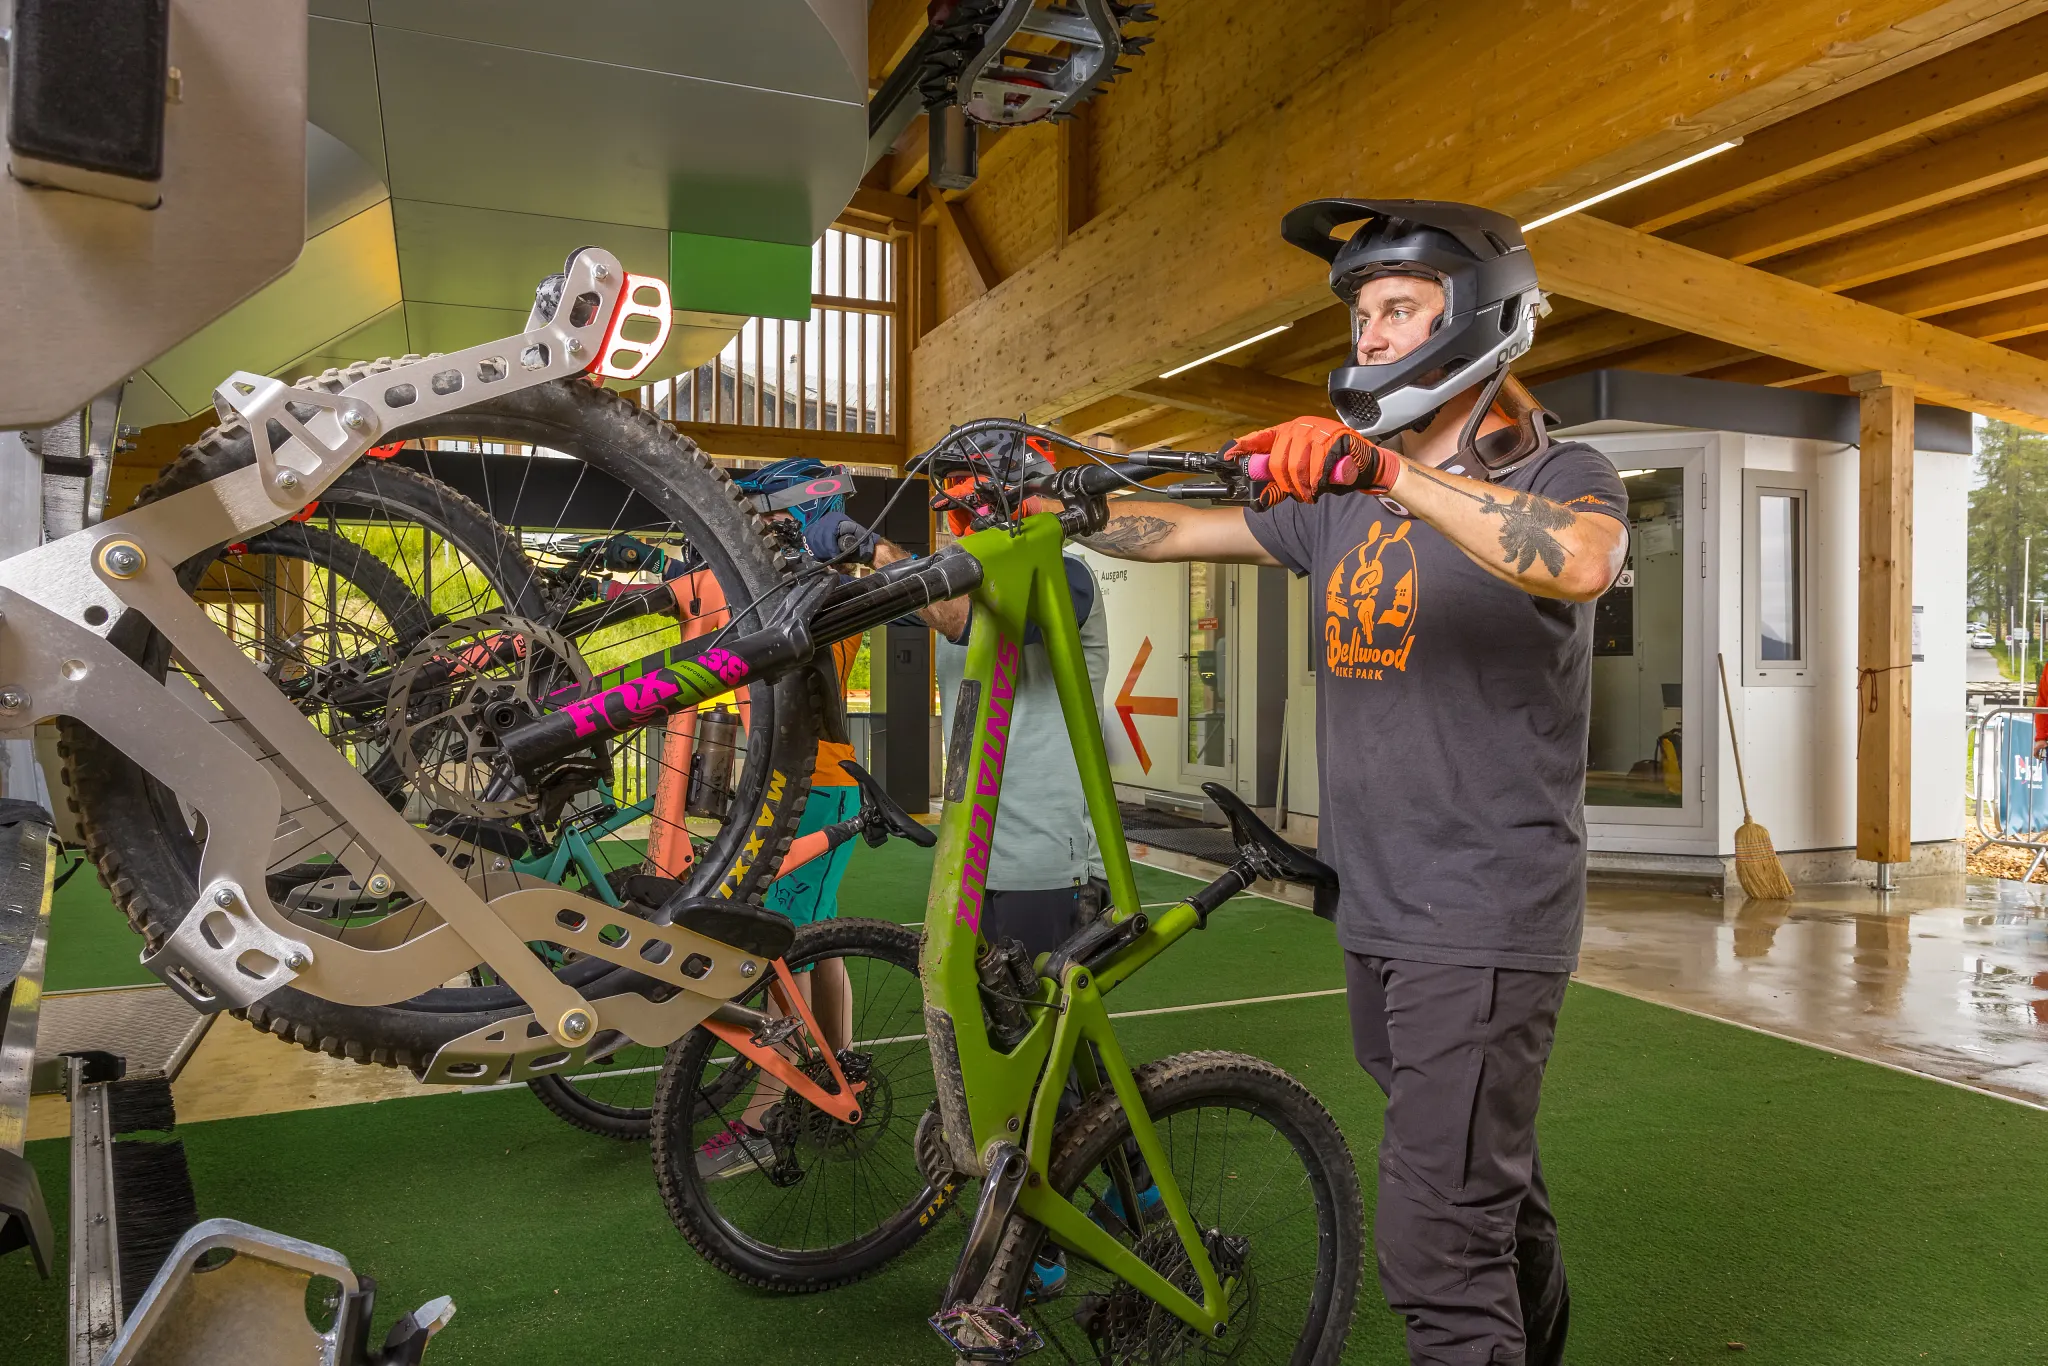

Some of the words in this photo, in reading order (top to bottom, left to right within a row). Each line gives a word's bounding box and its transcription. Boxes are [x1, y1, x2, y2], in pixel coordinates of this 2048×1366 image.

[1101, 569, 1128, 582] Ausgang
[698, 647, 749, 685] 38
[1325, 615, 1416, 672] Bellwood
[1335, 666, 1354, 679] BIKE
[1355, 668, 1385, 681] PARK
[562, 669, 680, 738] FOX
[975, 631, 1019, 797] SANTA
[711, 768, 788, 900] MAXXI
[955, 803, 993, 936] CRUZ
[919, 1182, 956, 1227] XXIS
